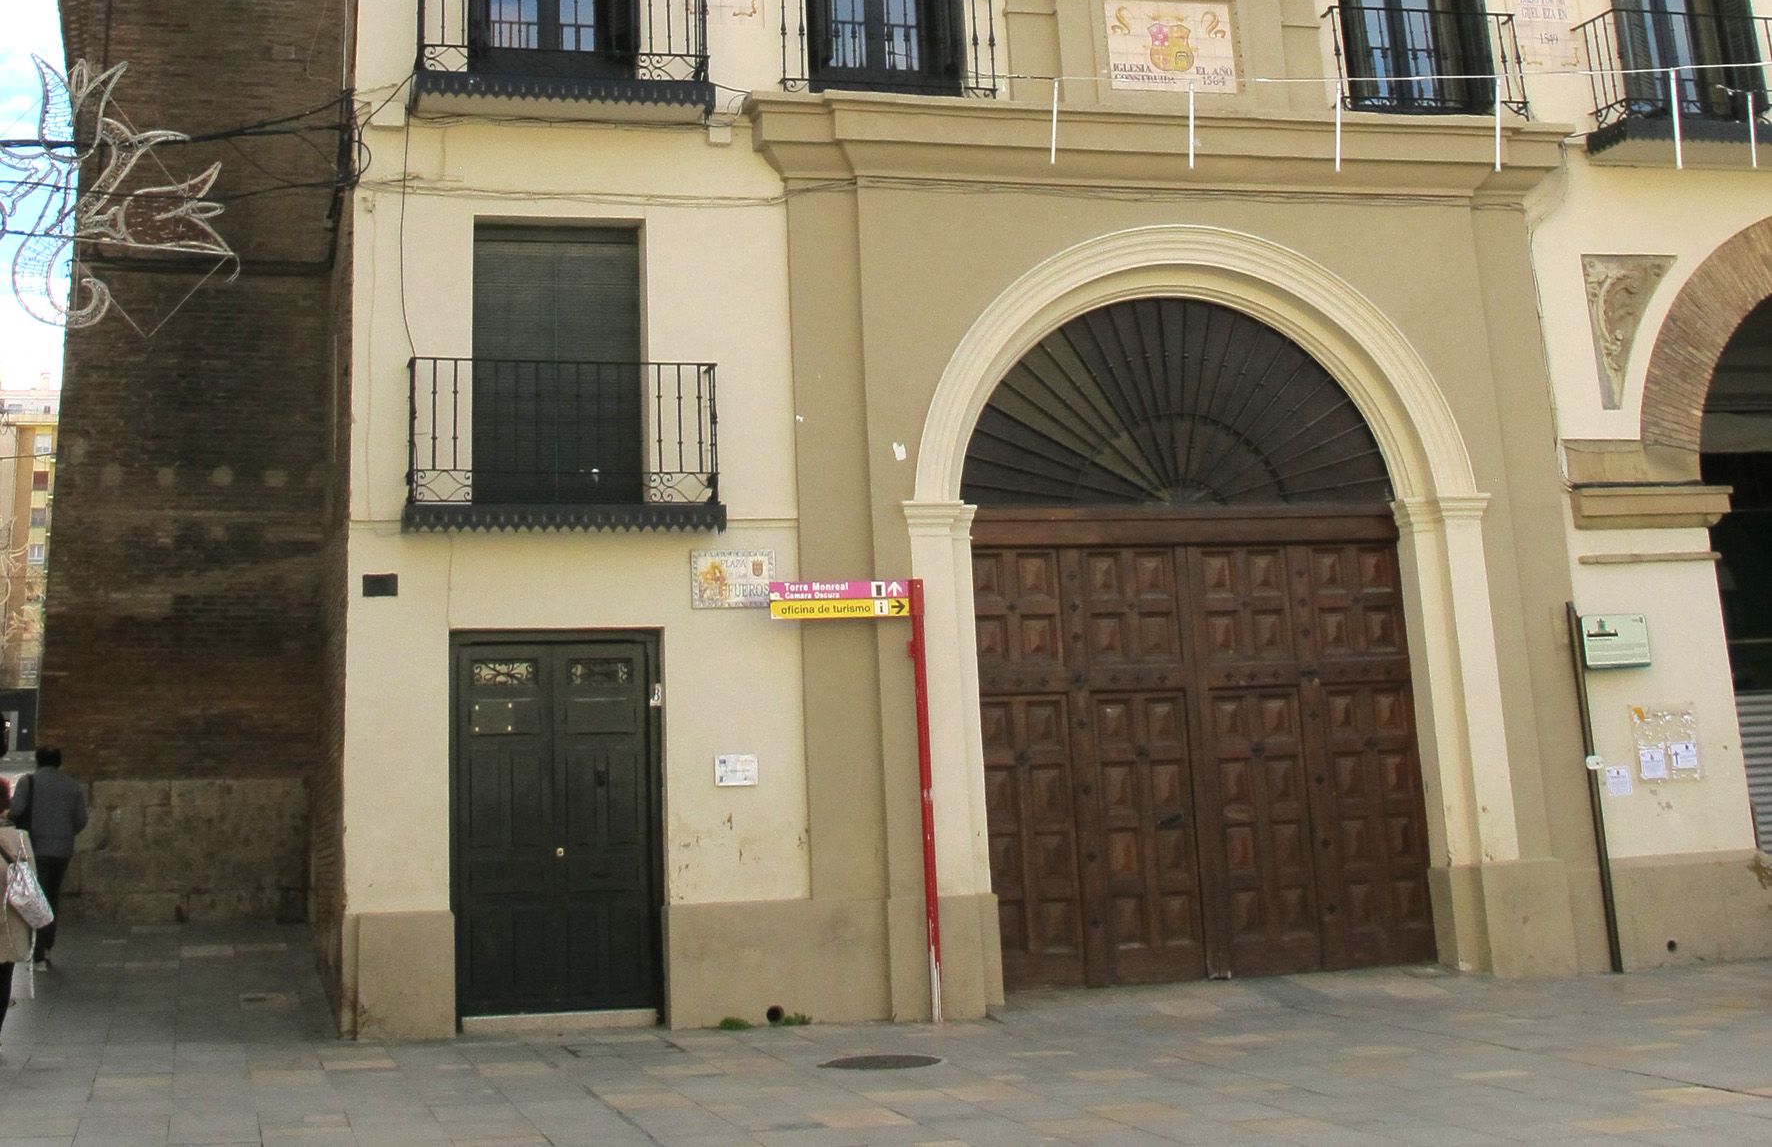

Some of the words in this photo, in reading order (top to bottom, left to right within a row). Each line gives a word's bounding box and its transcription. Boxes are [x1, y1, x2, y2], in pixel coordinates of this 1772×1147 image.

[1521, 7, 1541, 19] GUEL
[1542, 7, 1556, 19] EZA
[1558, 8, 1568, 20] EN
[1539, 33, 1559, 45] 1549
[1113, 63, 1153, 73] IGLESIA
[1195, 66, 1209, 75] EL
[1212, 66, 1234, 77] AÑO
[1114, 73, 1177, 84] CONSTRUIDA
[720, 559, 747, 568] PLAZA
[727, 583, 770, 597] FUEROS
[784, 582, 809, 592] Torre
[812, 581, 849, 591] Monreal
[784, 591, 812, 600] Camara
[814, 591, 840, 599] Oscura
[781, 604, 815, 615] oficina
[817, 604, 830, 614] de
[833, 604, 871, 614] turismo
